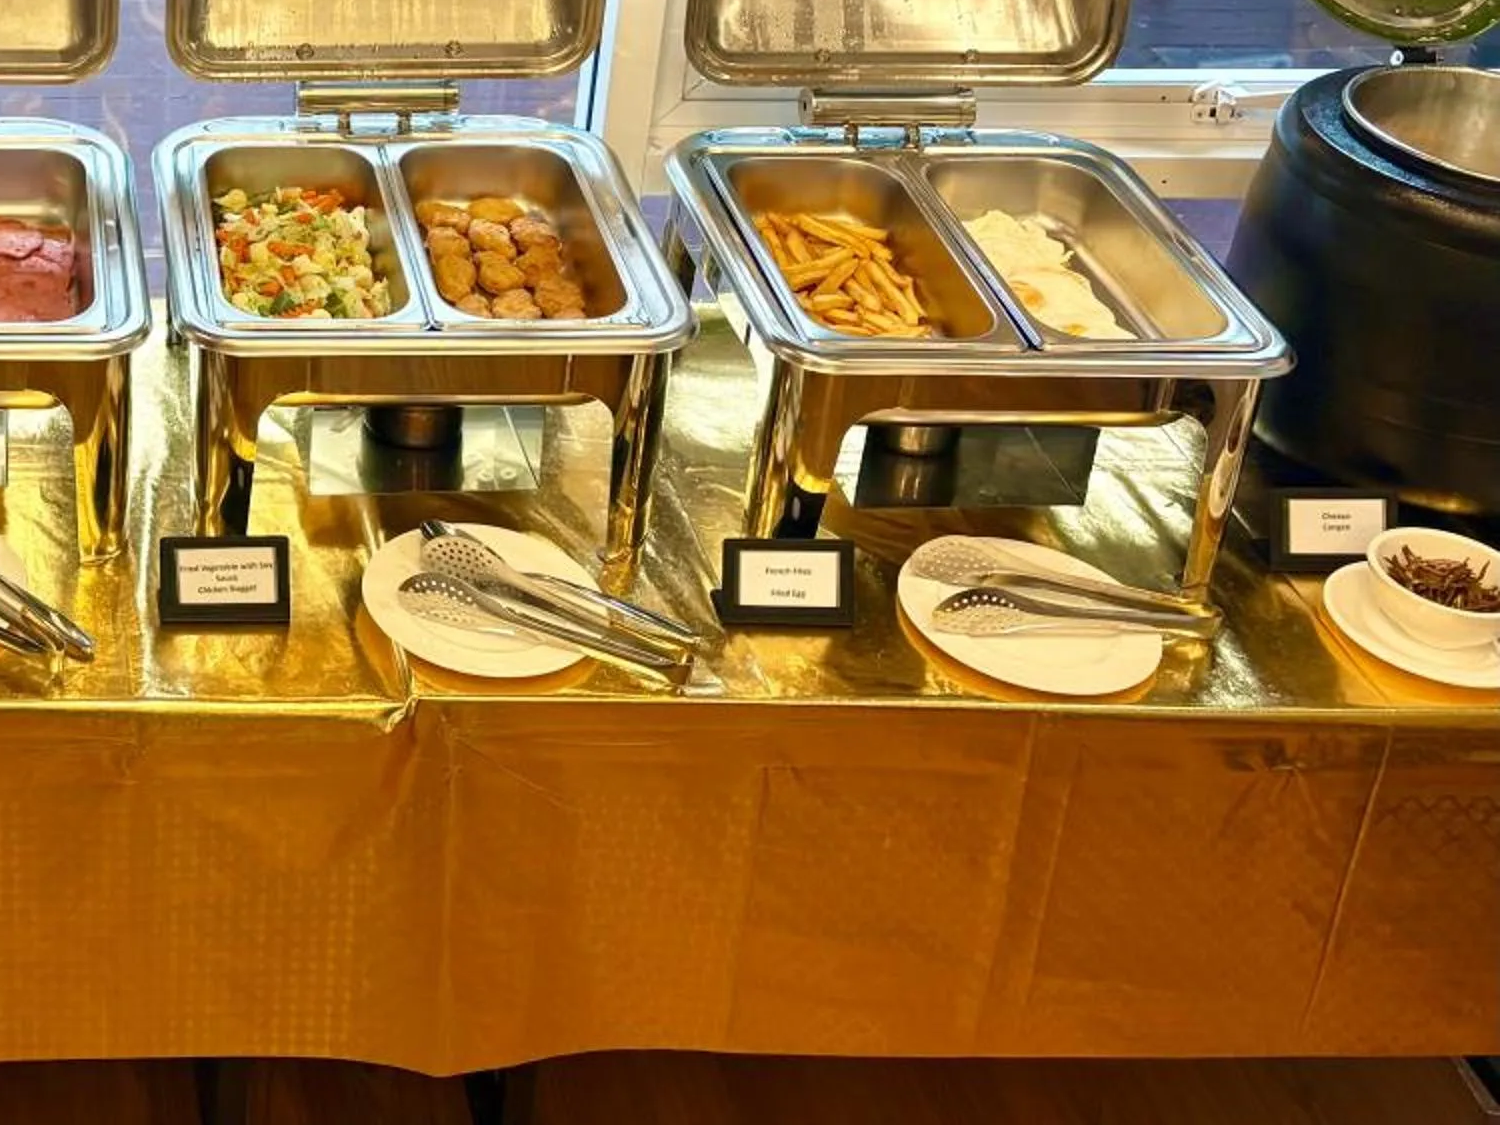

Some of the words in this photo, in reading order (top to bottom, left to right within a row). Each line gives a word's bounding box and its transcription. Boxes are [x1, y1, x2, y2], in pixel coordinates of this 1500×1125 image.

[201, 563, 238, 573] Vegetable
[240, 561, 257, 570] with
[197, 585, 227, 594] Chicken
[229, 584, 257, 594] Nugget
